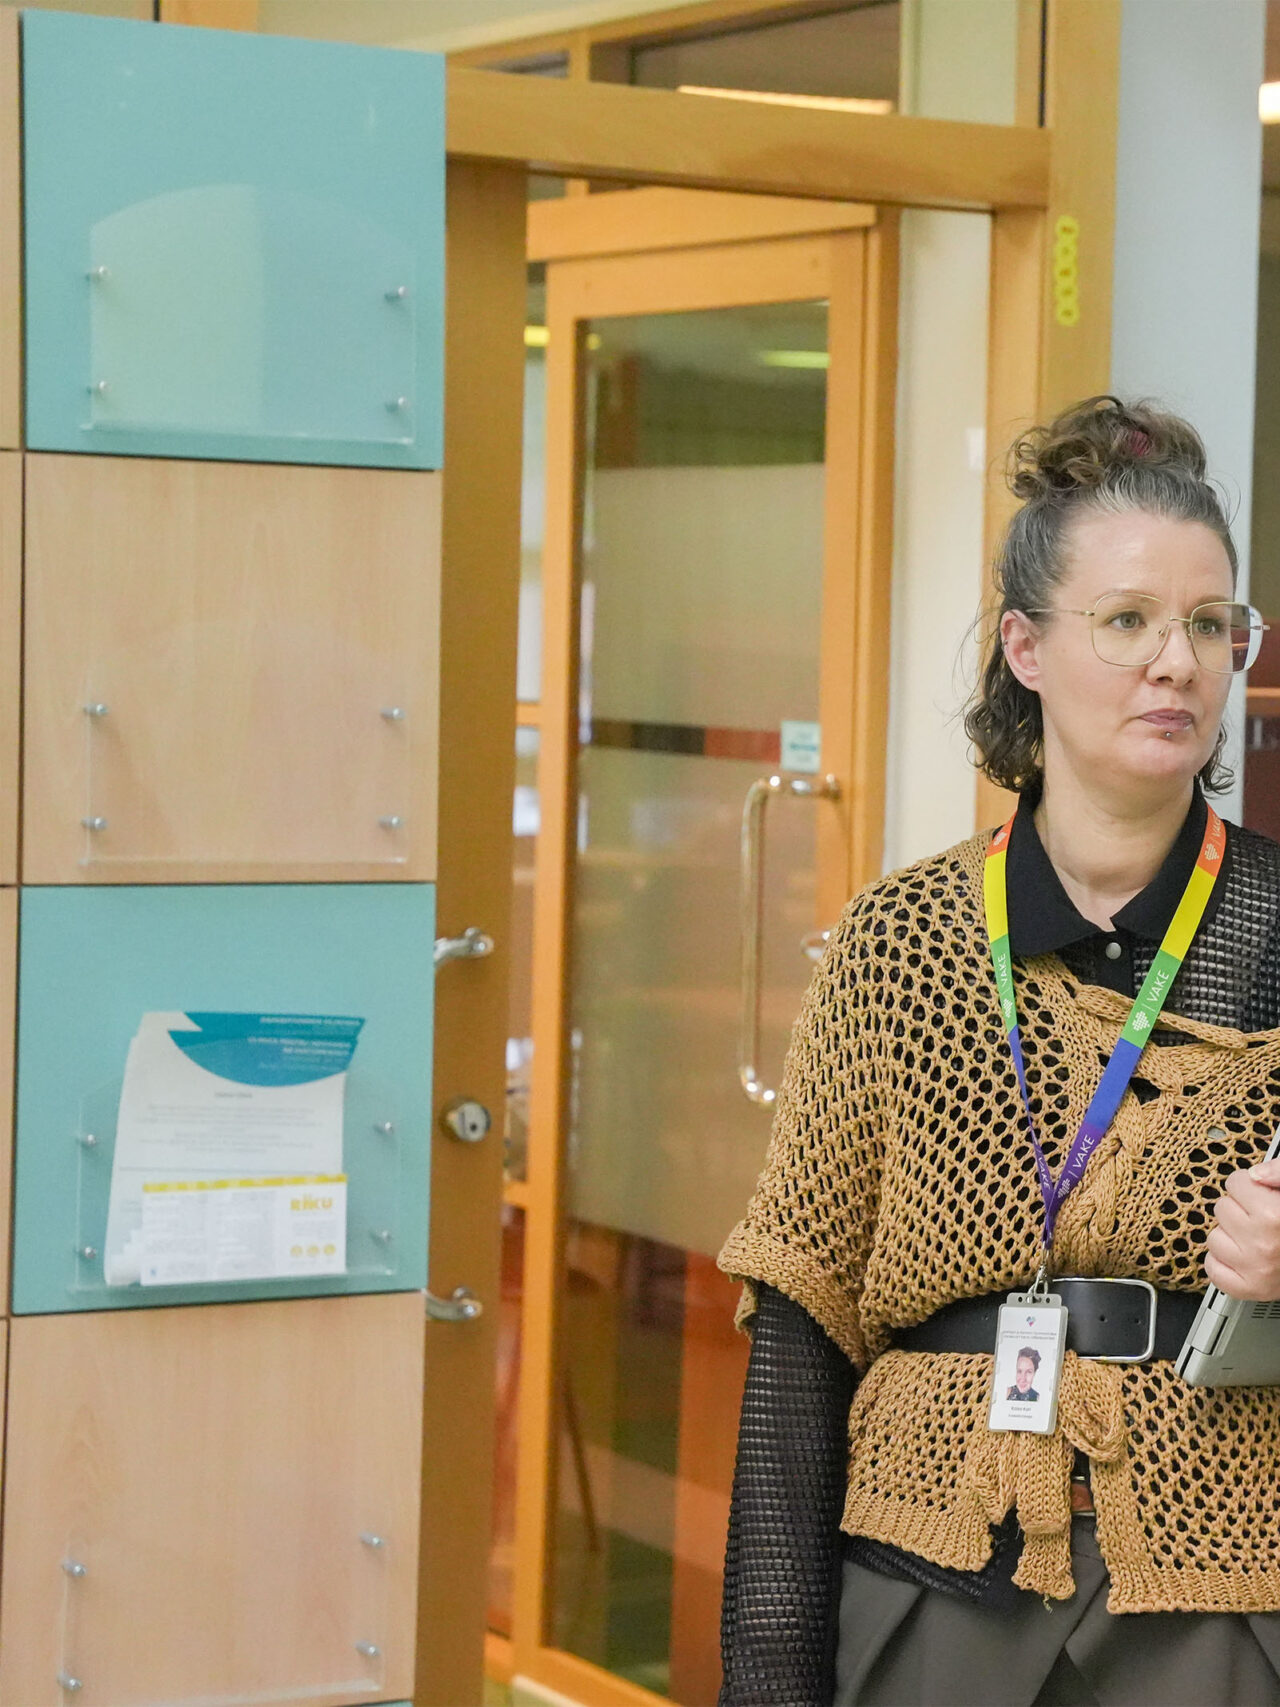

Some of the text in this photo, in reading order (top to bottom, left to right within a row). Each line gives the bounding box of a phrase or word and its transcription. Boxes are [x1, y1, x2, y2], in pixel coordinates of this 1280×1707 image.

[998, 953, 1008, 987] VAKE
[1147, 970, 1170, 1002] VAKE
[1072, 1134, 1095, 1168] VAKE
